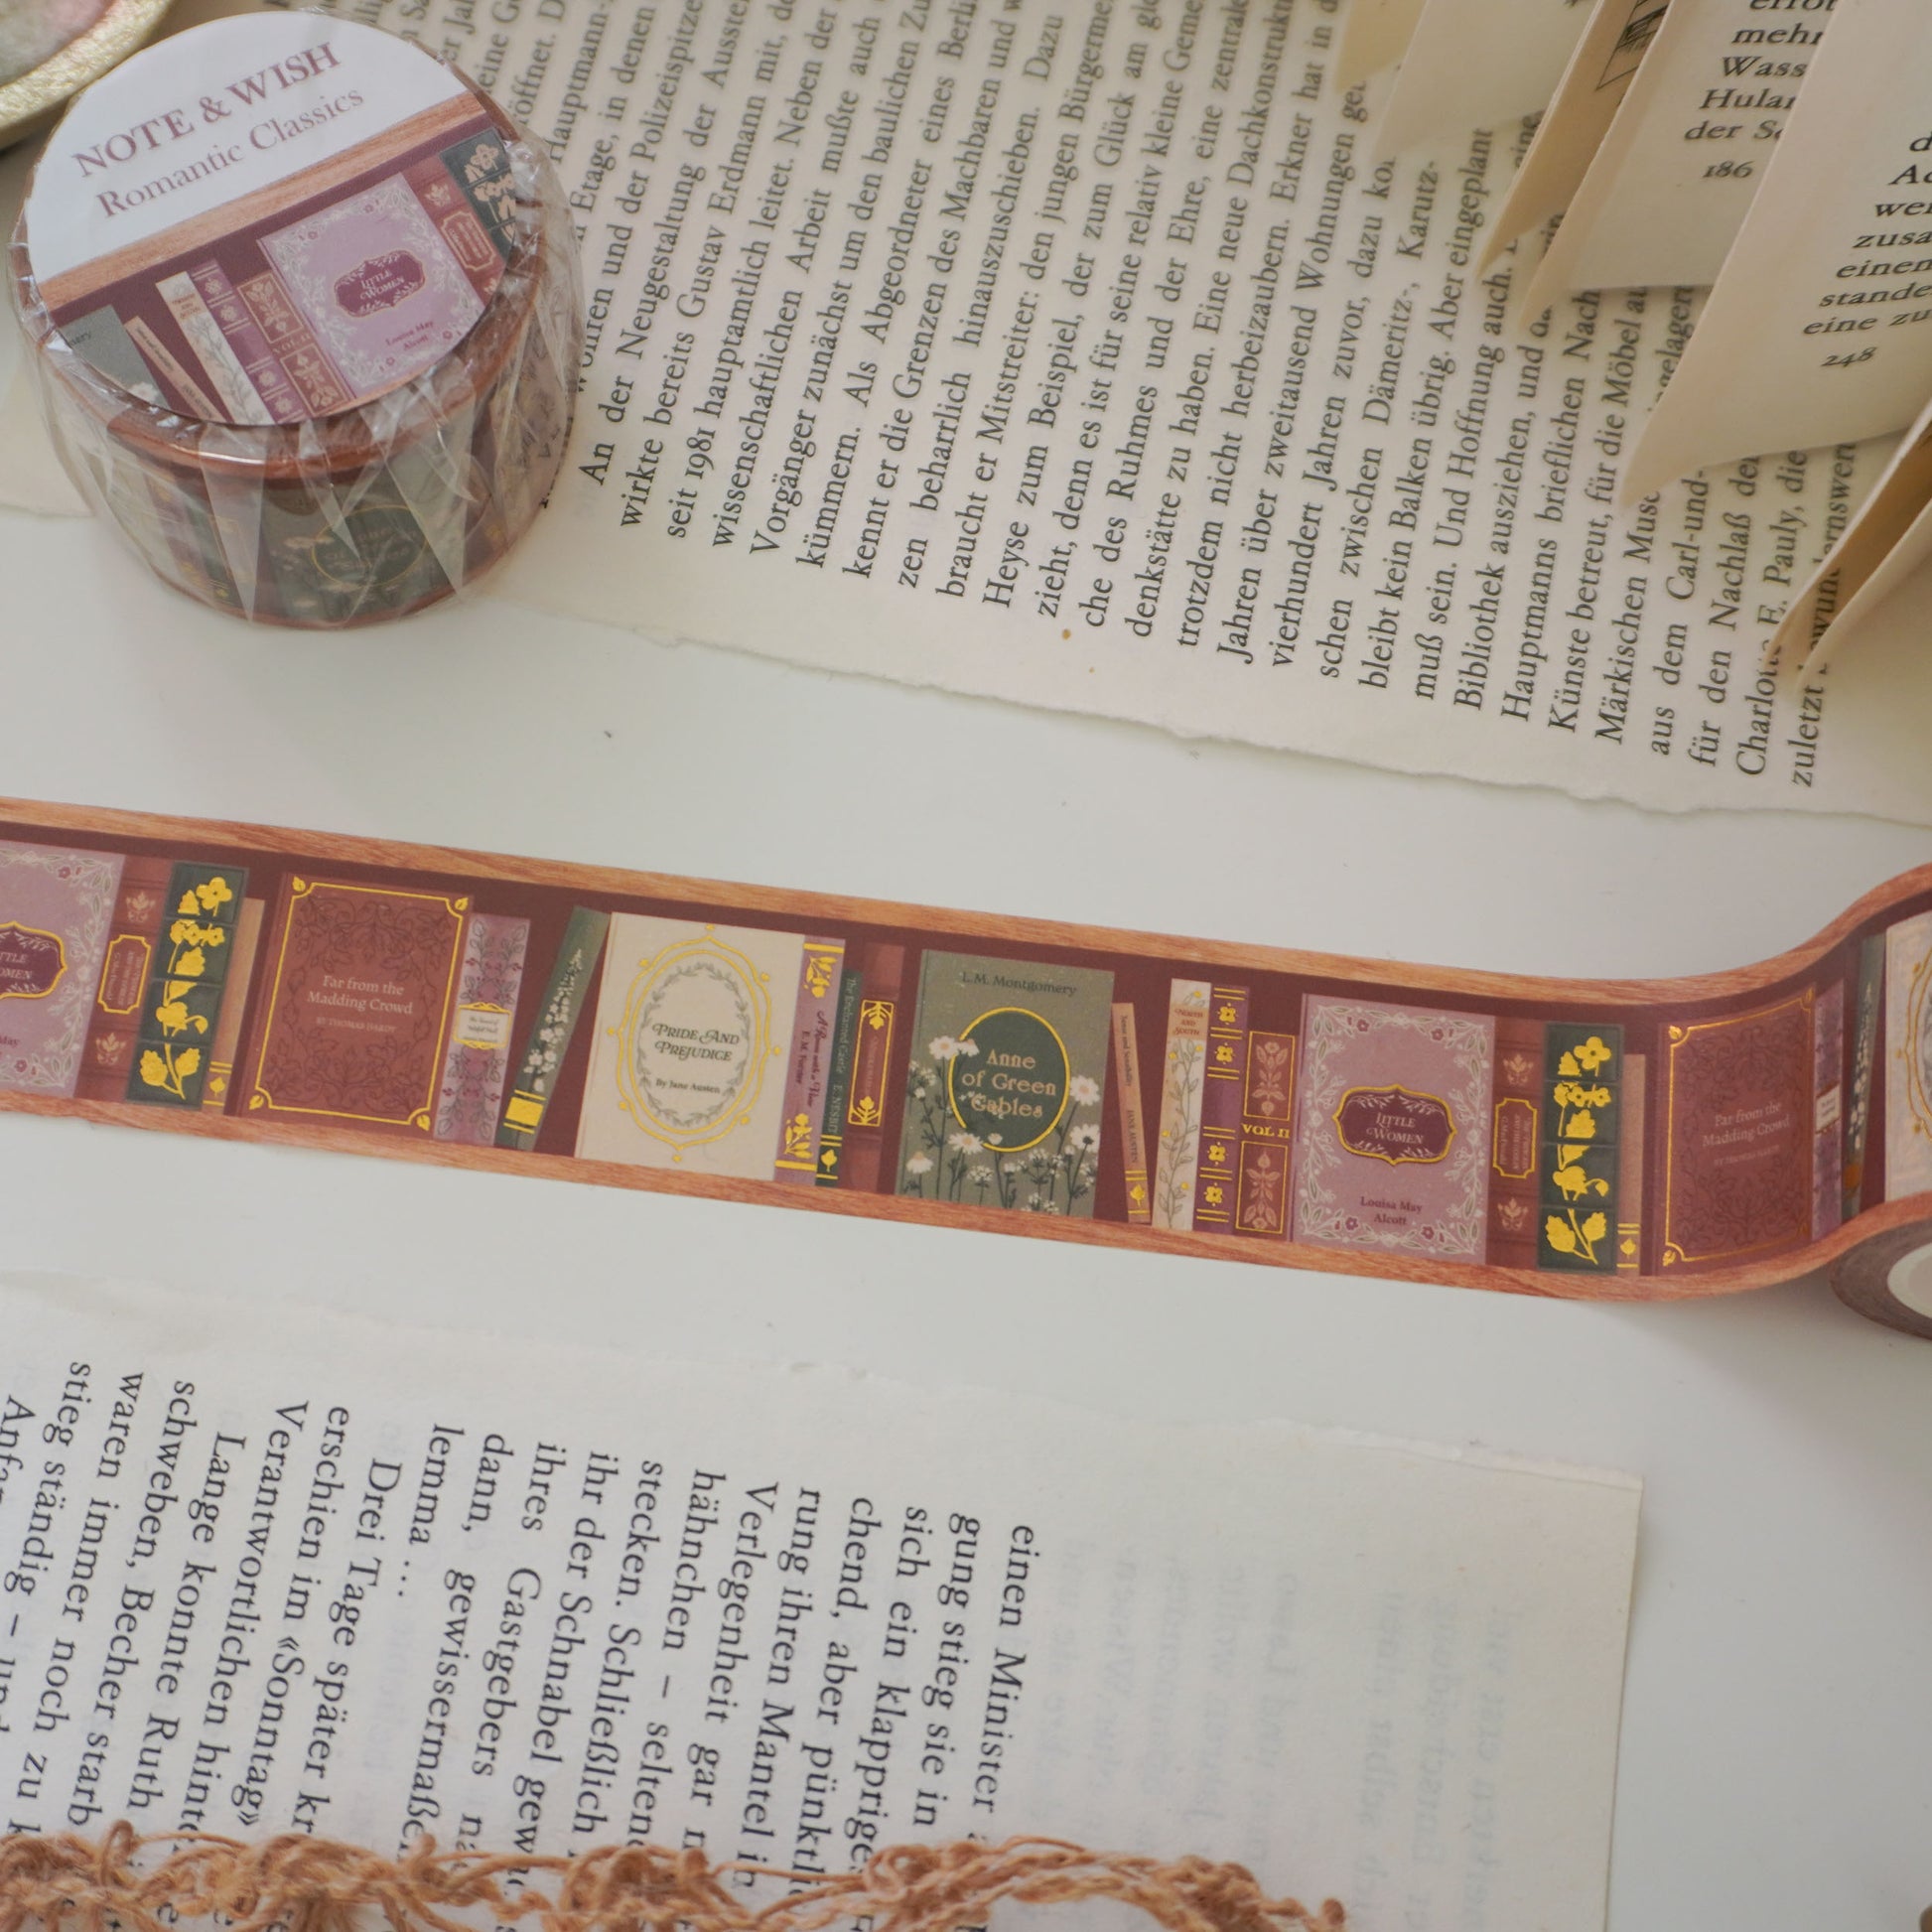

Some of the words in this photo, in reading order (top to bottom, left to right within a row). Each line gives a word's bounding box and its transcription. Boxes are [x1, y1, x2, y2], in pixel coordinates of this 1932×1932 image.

[71, 108, 196, 179] NOTE
[199, 96, 232, 124] &
[225, 42, 341, 106] WISH
[1722, 56, 1808, 77] Wass
[96, 143, 246, 218] Romantic
[248, 89, 364, 151] Classics
[1684, 120, 1743, 141] der
[1702, 161, 1755, 180] 186
[749, 159, 793, 230] leitet.
[952, 108, 1039, 347] hinauszuschieben.
[578, 443, 615, 485] An
[598, 375, 633, 423] der
[616, 164, 706, 359] Neugestaltung
[683, 104, 716, 147] der
[860, 159, 932, 345] Abgeordneter
[620, 439, 663, 526] wirkte
[642, 332, 695, 425] bereits
[676, 225, 726, 318] Gustav
[707, 96, 765, 214] Erdmann
[693, 240, 770, 419] hauptamtlich
[1220, 219, 1289, 418] herbeizaubern.
[1803, 316, 1878, 336] eine
[1821, 346, 1878, 368] 248
[712, 290, 803, 546] wissenschaftlichen
[785, 189, 831, 274] Arbeit
[843, 361, 878, 408] Als
[1169, 347, 1214, 436] haben.
[684, 427, 716, 480] 1981
[749, 409, 816, 554] Vorgänger
[802, 280, 852, 403] zunächst
[908, 372, 971, 511] beharrlich
[794, 427, 861, 569] kümmern.
[1166, 447, 1191, 483] zu
[1207, 431, 1242, 506] nicht
[1388, 438, 1432, 531] Balken
[1776, 450, 1813, 493] die
[667, 487, 697, 538] seit
[1762, 506, 1806, 587] Pauly,
[897, 538, 928, 589] zen
[1124, 492, 1181, 637] denkstätte
[1176, 520, 1223, 646] trotzdem
[1216, 568, 1262, 664] Jahren
[1240, 488, 1278, 553] über
[1374, 541, 1413, 601] kein
[1452, 563, 1505, 711] Bibliothek
[1490, 411, 1535, 555] ausziehen,
[1565, 514, 1612, 621] betreut,
[1708, 512, 1751, 631] Nachlaß
[1357, 608, 1400, 688] bleibt
[1547, 628, 1590, 733] Künste
[1593, 577, 1647, 745] Märkischen
[1698, 650, 1731, 704] den
[1687, 720, 1721, 766] für
[1787, 685, 1824, 787] zuletzt
[307, 991, 367, 1012] Madding
[369, 998, 414, 1015] Crowd
[322, 975, 345, 990] Far
[347, 977, 379, 992] from
[381, 981, 405, 996] the
[993, 975, 1077, 997] Montgomery
[651, 1024, 699, 1040] PRIDE
[699, 1030, 740, 1044] AND
[654, 1040, 733, 1061] PREJUDICE
[987, 1049, 1036, 1069] Anne
[962, 1070, 986, 1087] of
[992, 1073, 1056, 1096] Green
[971, 1093, 1042, 1118] Gables
[1376, 1112, 1417, 1129] LITTLE
[1366, 1127, 1424, 1145] WOMEN
[1360, 1196, 1397, 1209] Louisa
[1401, 1200, 1423, 1214] May
[1373, 1213, 1407, 1226] Alcott
[42, 1361, 91, 1447] stieg
[96, 1372, 144, 1478] waren
[125, 1380, 198, 1568] schweben,
[297, 1406, 349, 1559] erschien
[354, 1457, 403, 1541] Drei
[408, 1423, 465, 1545] lemma
[461, 1434, 514, 1532] dann,
[520, 1442, 567, 1531] ihres
[3, 1460, 66, 1596] ständig
[62, 1497, 119, 1622] immer
[203, 1400, 309, 1725] Verantwortlichen
[615, 1460, 663, 1606] stecken.
[661, 1468, 727, 1650] hähnchen
[776, 1486, 821, 1575] rung
[829, 1497, 883, 1618] chend,
[937, 1512, 981, 1609] gung
[282, 1573, 321, 1620] im
[328, 1557, 382, 1646] Tage
[704, 1481, 779, 1724] Verlegenheit
[999, 1525, 1040, 1626] einen
[93, 1584, 155, 1720] Becher
[472, 1568, 541, 1776] Gastgebers
[766, 1587, 813, 1684] ihren
[921, 1621, 969, 1710] stieg
[33, 1637, 75, 1731] noch
[304, 1661, 348, 1779] später
[572, 1623, 641, 1833] Schließlich
[816, 1641, 858, 1725] aber
[972, 1647, 1027, 1813] Minister
[16, 1752, 48, 1799] zu
[230, 1635, 305, 1826] «Sonntag»
[687, 1742, 720, 1807] gar
[741, 1699, 795, 1837] Mantel
[920, 1723, 955, 1775] sie
[68, 1731, 109, 1826] starb
[912, 1789, 948, 1826] in
